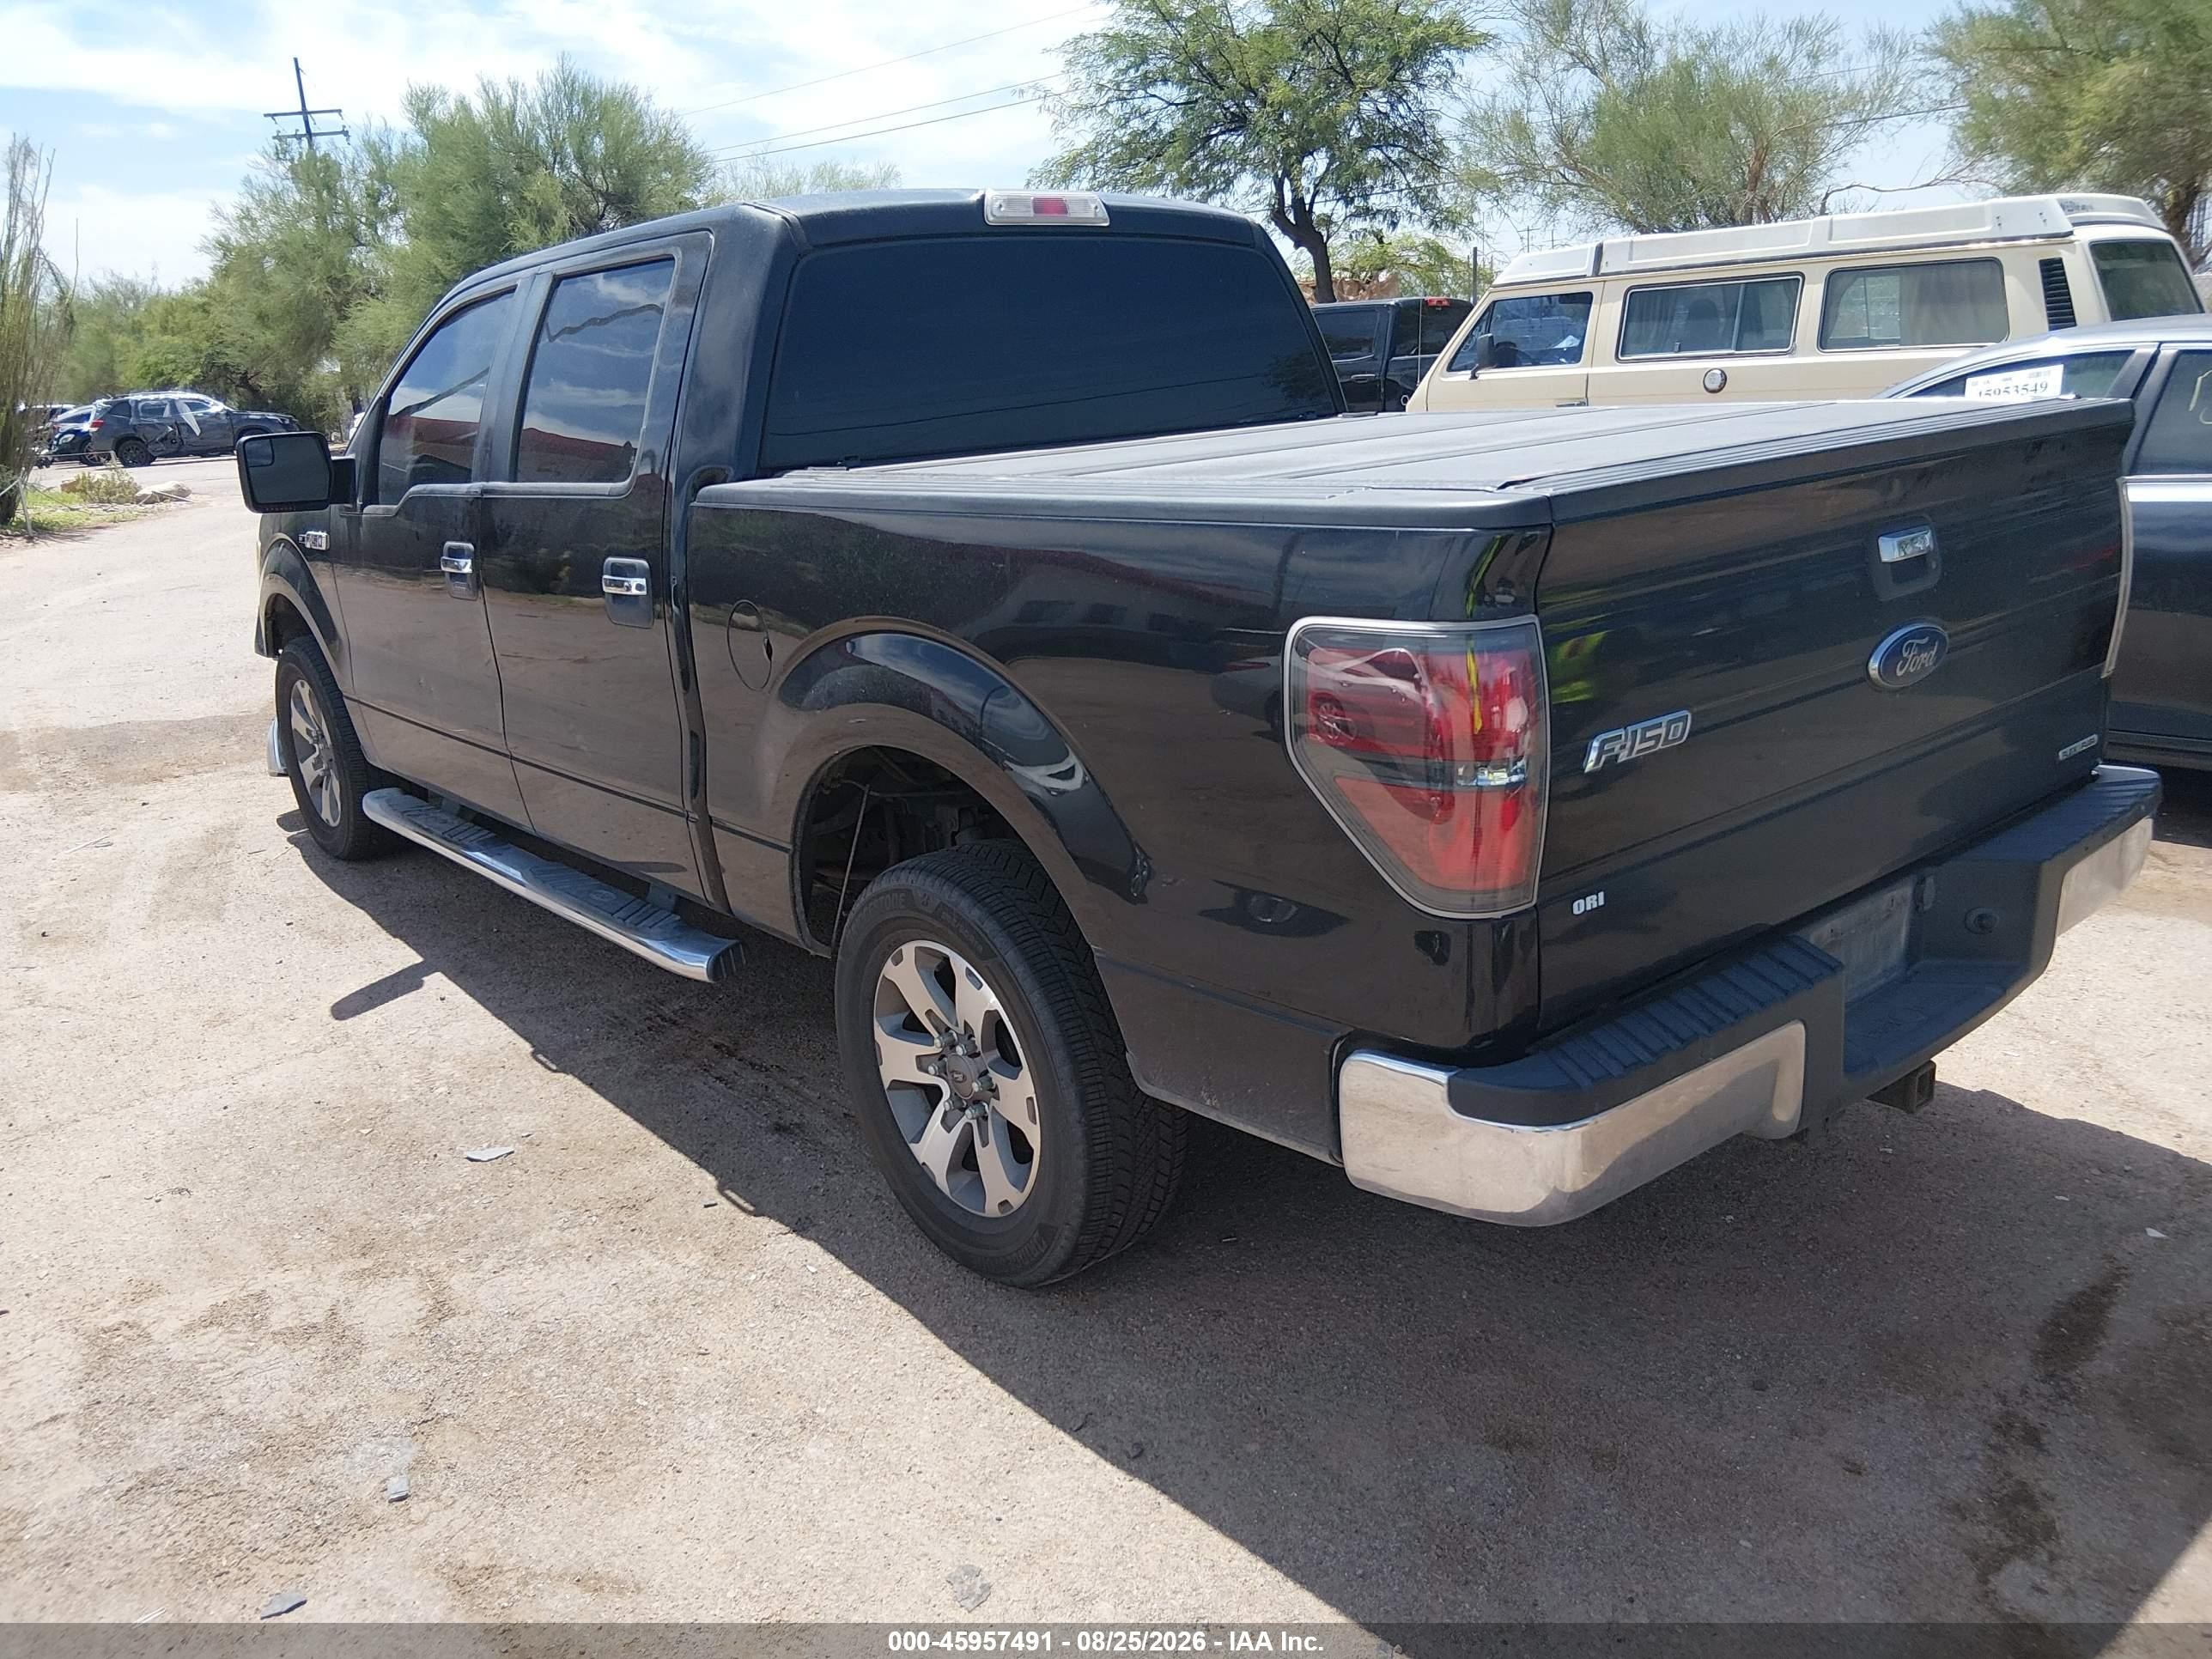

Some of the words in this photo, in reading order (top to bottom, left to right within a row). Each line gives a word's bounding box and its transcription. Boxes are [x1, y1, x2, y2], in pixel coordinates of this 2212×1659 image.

[1896, 636, 1938, 677] Ford
[1584, 710, 1691, 773] F-150
[1572, 890, 1605, 915] ORI
